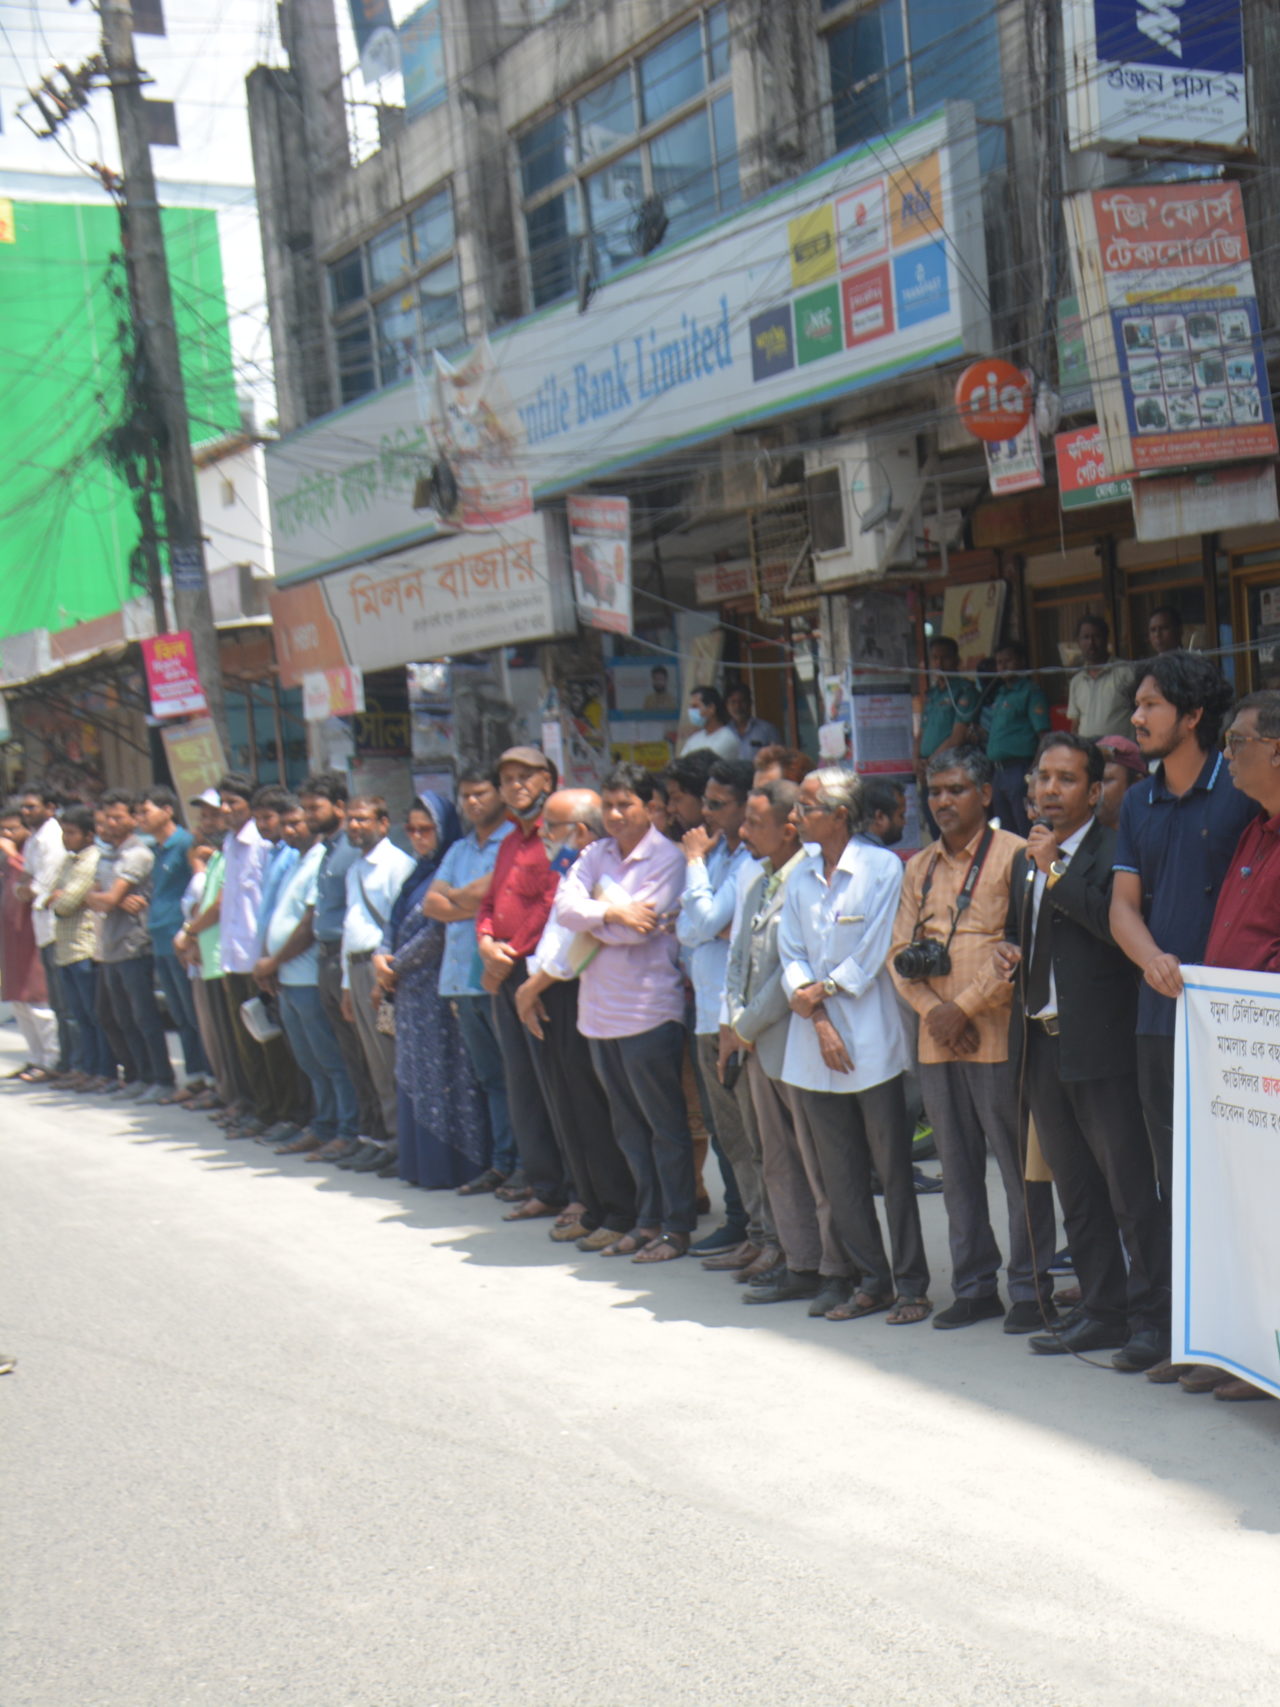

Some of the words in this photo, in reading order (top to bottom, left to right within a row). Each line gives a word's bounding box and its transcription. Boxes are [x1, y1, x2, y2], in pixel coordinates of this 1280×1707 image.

[1106, 228, 1243, 269] টেকনোলজি
[573, 342, 633, 425] Bank
[634, 293, 733, 401] Limited
[970, 372, 1023, 412] ria
[433, 538, 540, 603] বাজার
[1232, 999, 1280, 1026] টেলিভিশনের
[1251, 1040, 1265, 1058] এক
